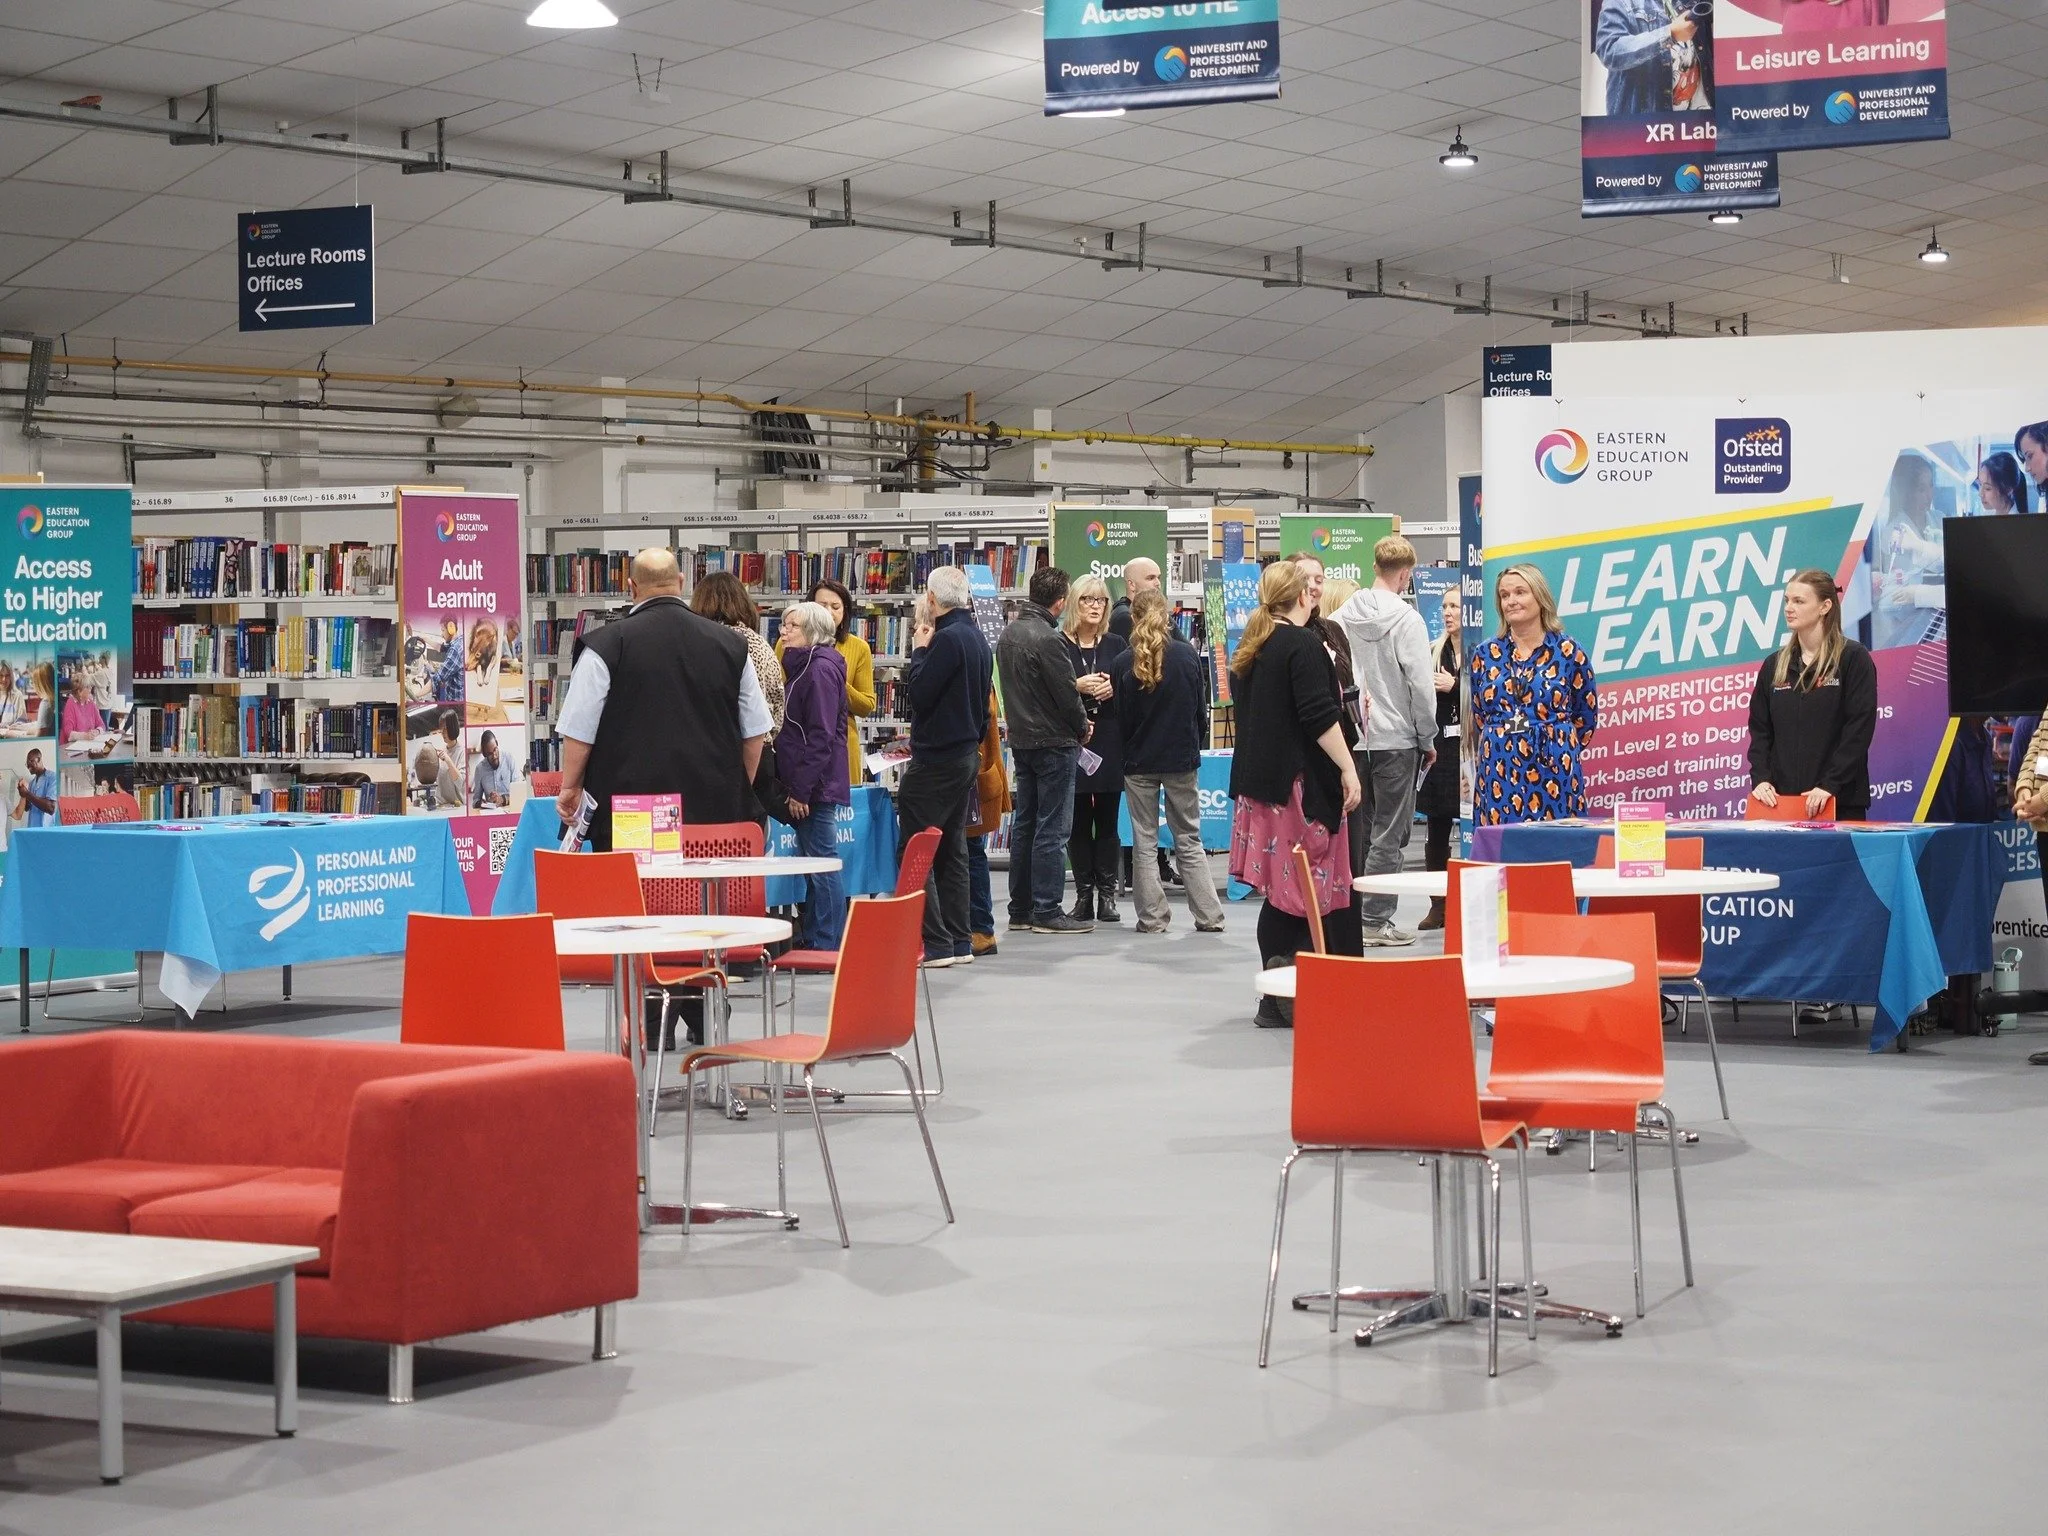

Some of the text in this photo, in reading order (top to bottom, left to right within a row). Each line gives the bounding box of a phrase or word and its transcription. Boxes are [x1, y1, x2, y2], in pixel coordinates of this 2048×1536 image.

[1081, 3, 1165, 25] Access
[1190, 39, 1268, 55] UNIVERSITY AND
[1736, 38, 1930, 71] Leisure Learning
[1190, 52, 1261, 66] PROFESSIONAL
[1061, 59, 1140, 77] Powered by
[1190, 64, 1260, 79] DEVELOPMENT
[1859, 84, 1936, 99] UNIVERSITY AND
[1859, 97, 1930, 110] PROFESSIONAL
[1731, 103, 1810, 121] Powered by
[1859, 107, 1928, 121] DEVELOPMENT
[1646, 122, 1717, 143] XR Lab
[1703, 160, 1768, 173] UNIVERSITY AND
[1595, 174, 1662, 189] Powered by
[1703, 170, 1763, 181] PROFESSIONAL
[1703, 179, 1761, 191] DEVELOPMENT
[247, 248, 366, 269] Lecture Rooms
[247, 275, 303, 293] Offices
[1490, 370, 1552, 382] Lecture Ro
[1490, 387, 1531, 397] Offices
[1597, 432, 1665, 444] EASTERN
[1723, 438, 1782, 458] Ofsted
[1597, 451, 1689, 463] EDUCATION
[1597, 470, 1653, 482] GROUP
[1723, 463, 1782, 475] Outstanding
[1723, 474, 1764, 485] Provider
[148, 498, 172, 506] 616.89
[263, 495, 288, 503] 616.89
[289, 494, 313, 503] (Cont.)
[380, 491, 389, 499] 37
[46, 507, 80, 516] EASTERN
[456, 512, 481, 522] EASTERN
[46, 519, 90, 527] EDUCATION
[456, 523, 489, 533] EDUCATION
[46, 531, 74, 539] GROUP
[457, 533, 477, 542] GROUP
[14, 555, 92, 579] Access
[440, 558, 484, 581] Adult
[1556, 526, 1797, 617] LEARN.
[4, 586, 103, 616] to Higher
[427, 587, 496, 613] Learning
[1462, 604, 1468, 627] &
[1, 617, 107, 643] Education
[1680, 698, 1704, 717] TO
[1613, 735, 1660, 756] Level
[1665, 732, 1676, 749] 2
[1682, 731, 1699, 746] to
[1705, 725, 1749, 744] Degr
[1673, 753, 1743, 775] training
[1631, 785, 1673, 802] from
[1679, 779, 1709, 796] the
[1679, 803, 1717, 820] with
[316, 845, 417, 872] PERSONAL AND
[317, 870, 415, 897] PROFESSIONAL
[318, 898, 385, 922] LEARNING
[1701, 896, 1794, 918] CATION
